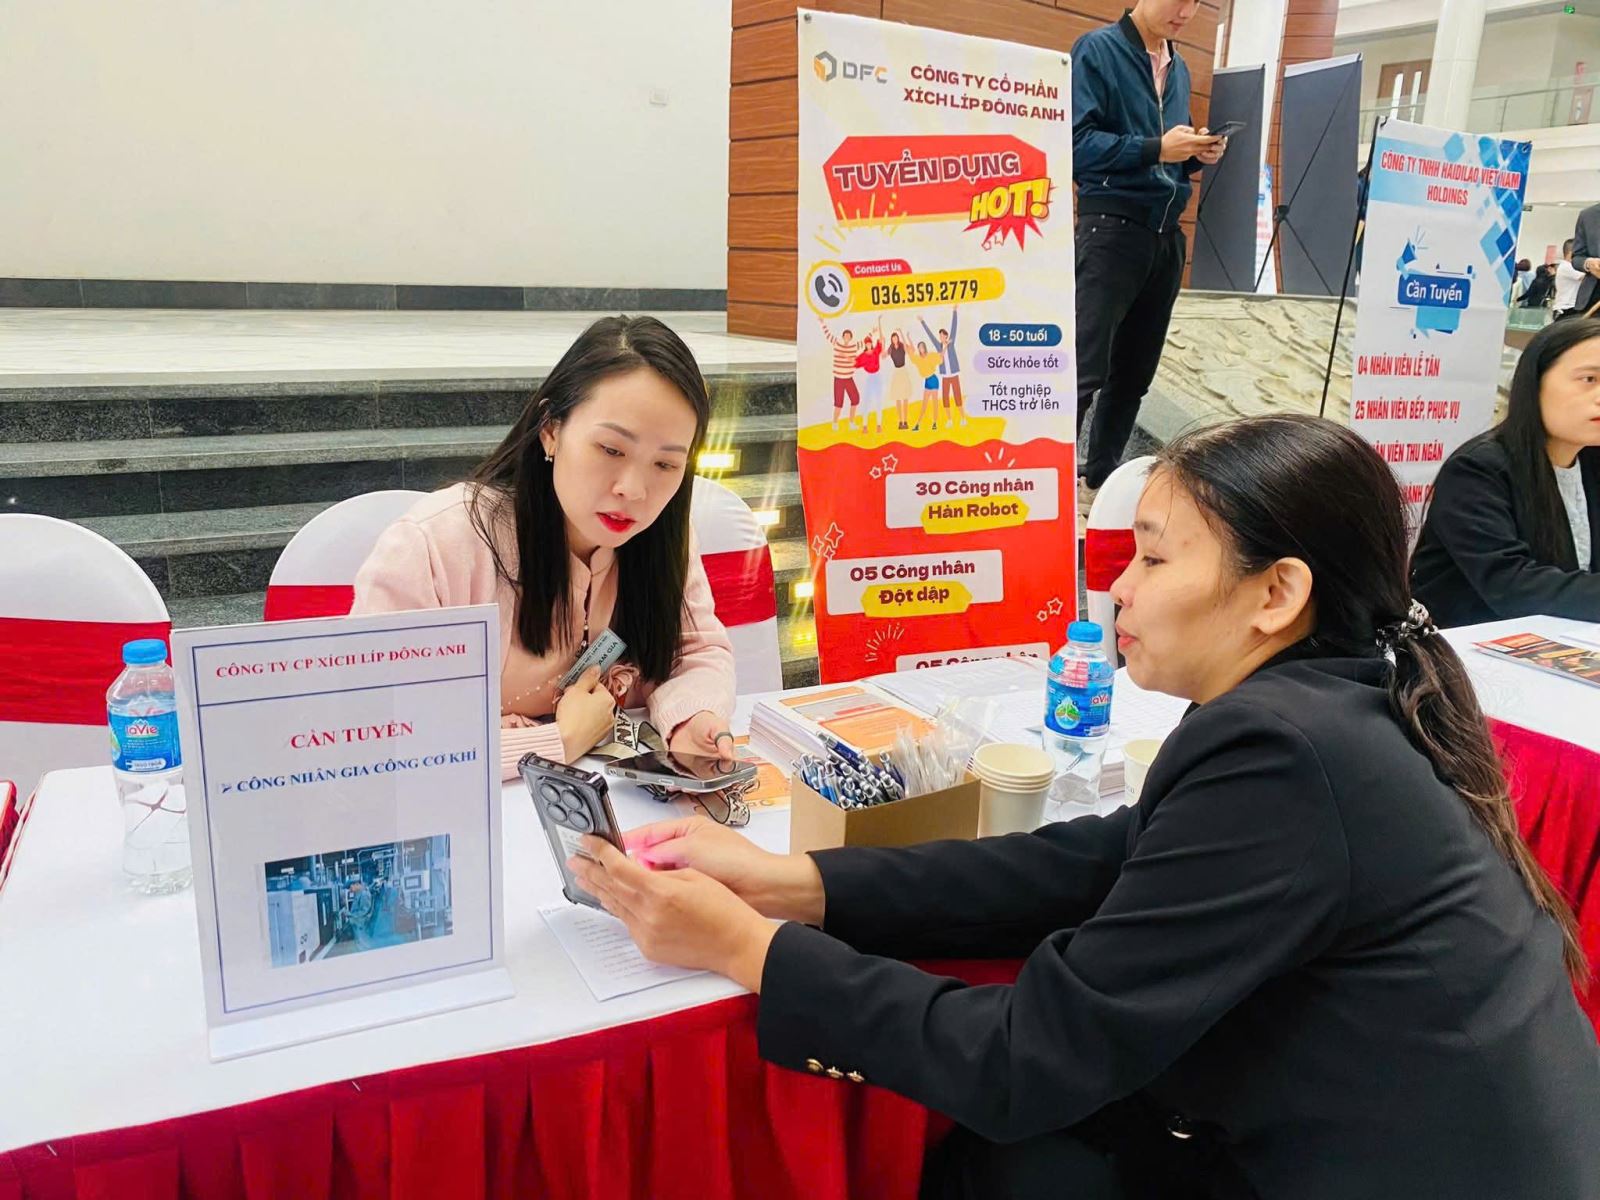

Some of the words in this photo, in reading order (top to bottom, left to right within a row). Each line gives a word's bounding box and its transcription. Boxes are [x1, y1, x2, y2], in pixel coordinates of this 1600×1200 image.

[843, 61, 888, 84] DFC
[911, 64, 959, 85] CÔNG
[962, 74, 985, 88] TY
[988, 72, 1011, 92] CỔ
[1014, 79, 1058, 99] PHẦN
[904, 87, 947, 106] XÍCH
[950, 94, 980, 110] LÍP
[982, 98, 1028, 117] ĐÔNG
[1030, 106, 1065, 121] ANH
[834, 149, 940, 191] TUYỂN
[941, 152, 1020, 186] DỤNG
[1382, 150, 1404, 171] CÔNG
[1407, 156, 1416, 173] TY
[1418, 158, 1440, 177] TNHH
[1441, 162, 1479, 183] HAIDILAO
[1499, 171, 1520, 189] NAM
[970, 178, 1051, 223] HOT!
[1427, 185, 1468, 205] HOLDINGS
[854, 264, 890, 275] Contact
[891, 263, 902, 273] Us
[871, 279, 978, 306] 036.359.2779
[1406, 280, 1426, 299] Cần
[988, 330, 1000, 341] 18
[1010, 330, 1024, 341] 50
[988, 356, 1010, 368] Sức
[1013, 356, 1040, 368] khỏe
[1044, 354, 1058, 368] tốt
[1358, 356, 1368, 374] 04
[1370, 352, 1393, 375] NHÂN
[1394, 352, 1412, 375] VIÊN
[990, 382, 1007, 395] Tốt
[1011, 384, 1051, 398] nghiệp
[982, 400, 1016, 410] THCS
[1020, 397, 1038, 410] trở
[1041, 399, 1059, 409] lên
[1355, 400, 1365, 419] 25
[1367, 396, 1389, 419] NHÂN
[1391, 396, 1408, 419] VIÊN
[1427, 401, 1448, 423] PHỤC
[1450, 401, 1460, 423] VỤ
[1388, 440, 1404, 461] VIÊN
[1406, 443, 1420, 462] THU
[1422, 440, 1444, 461] NGÂN
[916, 482, 941, 495] 30
[945, 481, 990, 497] Công
[994, 478, 1034, 492] nhân
[929, 504, 963, 519] Hàn
[967, 502, 1018, 517] Robot
[850, 566, 878, 582] 05
[882, 565, 929, 582] Công
[932, 560, 975, 576] nhân
[879, 589, 913, 606] Đột
[917, 586, 950, 602] dập
[216, 662, 263, 678] CÔNG
[268, 660, 288, 673] TY
[293, 659, 313, 670] CP
[317, 655, 356, 668] XÍCH
[361, 650, 385, 663] LÍP
[389, 647, 431, 661] ĐÔNG
[436, 644, 466, 657] ANH
[290, 728, 336, 749] CẦN
[342, 720, 413, 742] TUYỂN
[237, 776, 285, 792] CÔNG
[290, 767, 336, 785] NHÂN
[341, 766, 369, 778] GIA
[374, 759, 419, 774] CÔNG
[423, 754, 446, 767] CƠ
[450, 748, 476, 764] KHÍ
